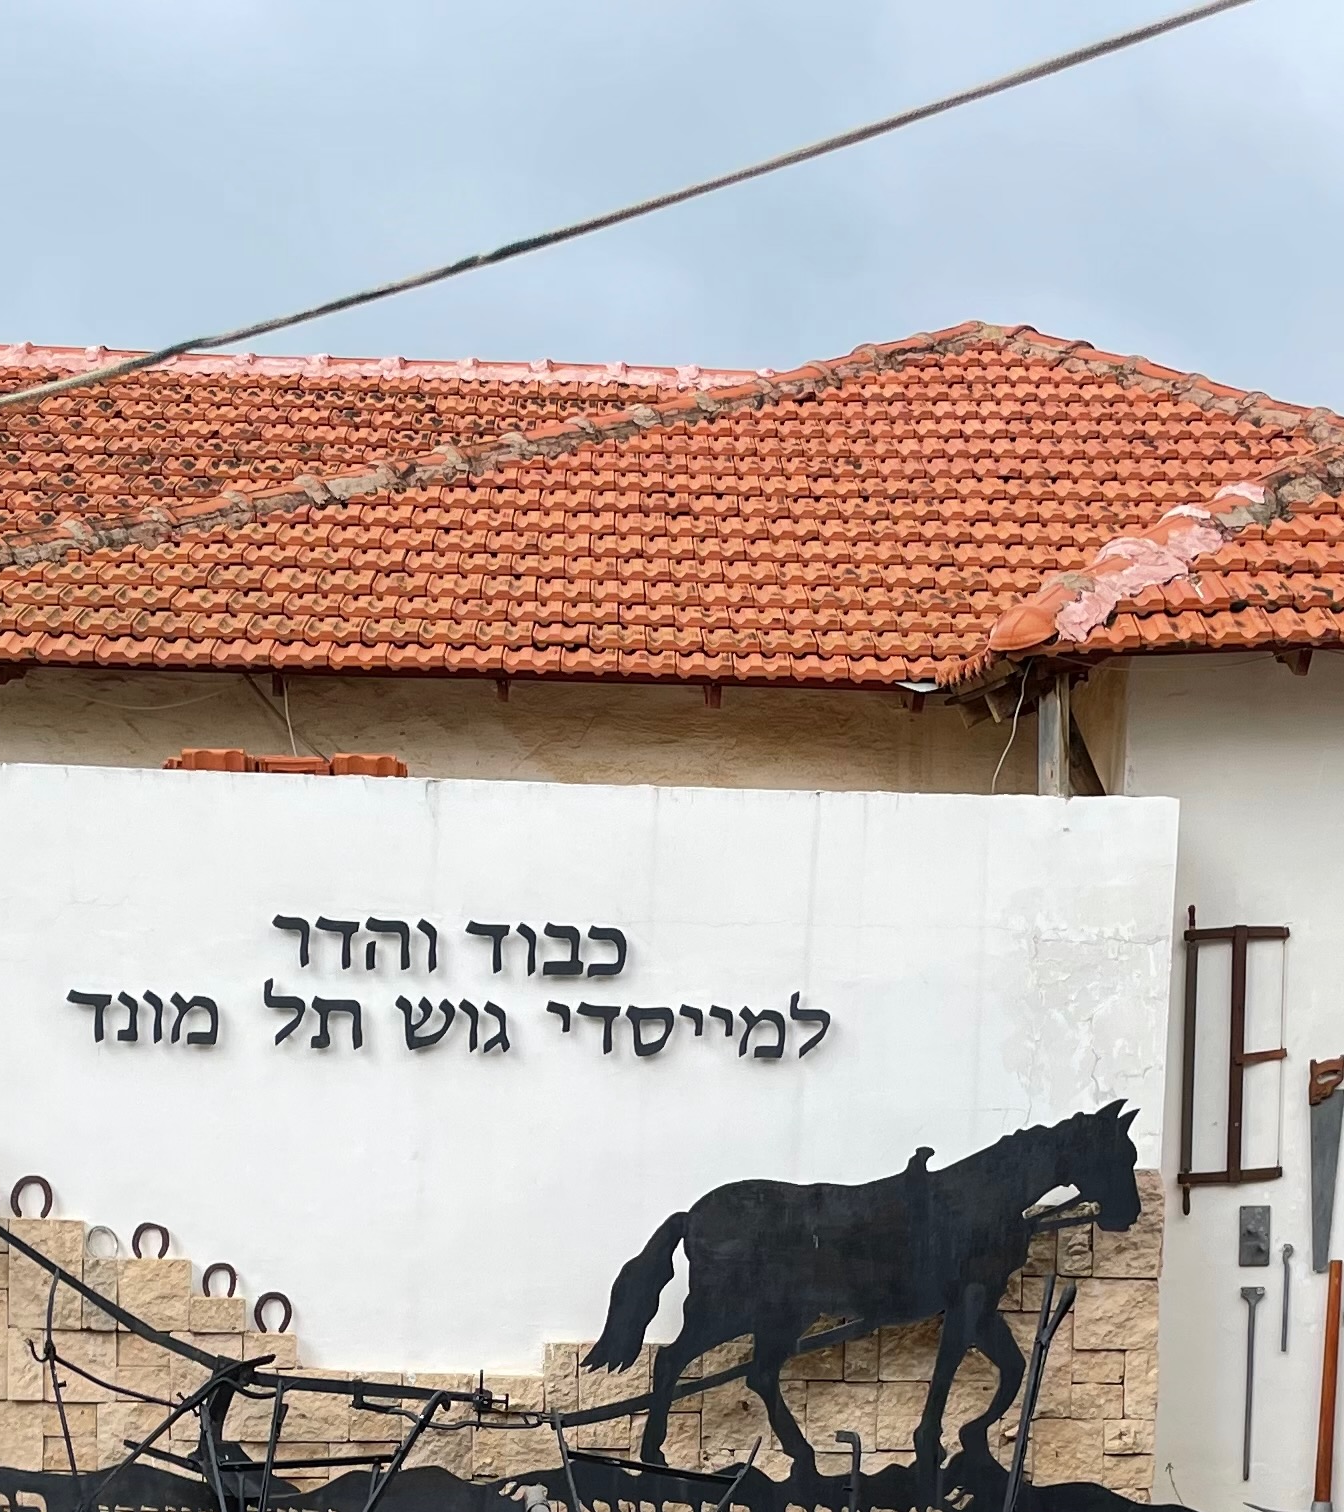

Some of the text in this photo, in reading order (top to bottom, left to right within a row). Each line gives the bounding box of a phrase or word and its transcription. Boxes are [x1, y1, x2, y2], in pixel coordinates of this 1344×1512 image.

[271, 914, 627, 977] כבוד והדר
[66, 978, 831, 1059] למייסדי גוש תל מונד
